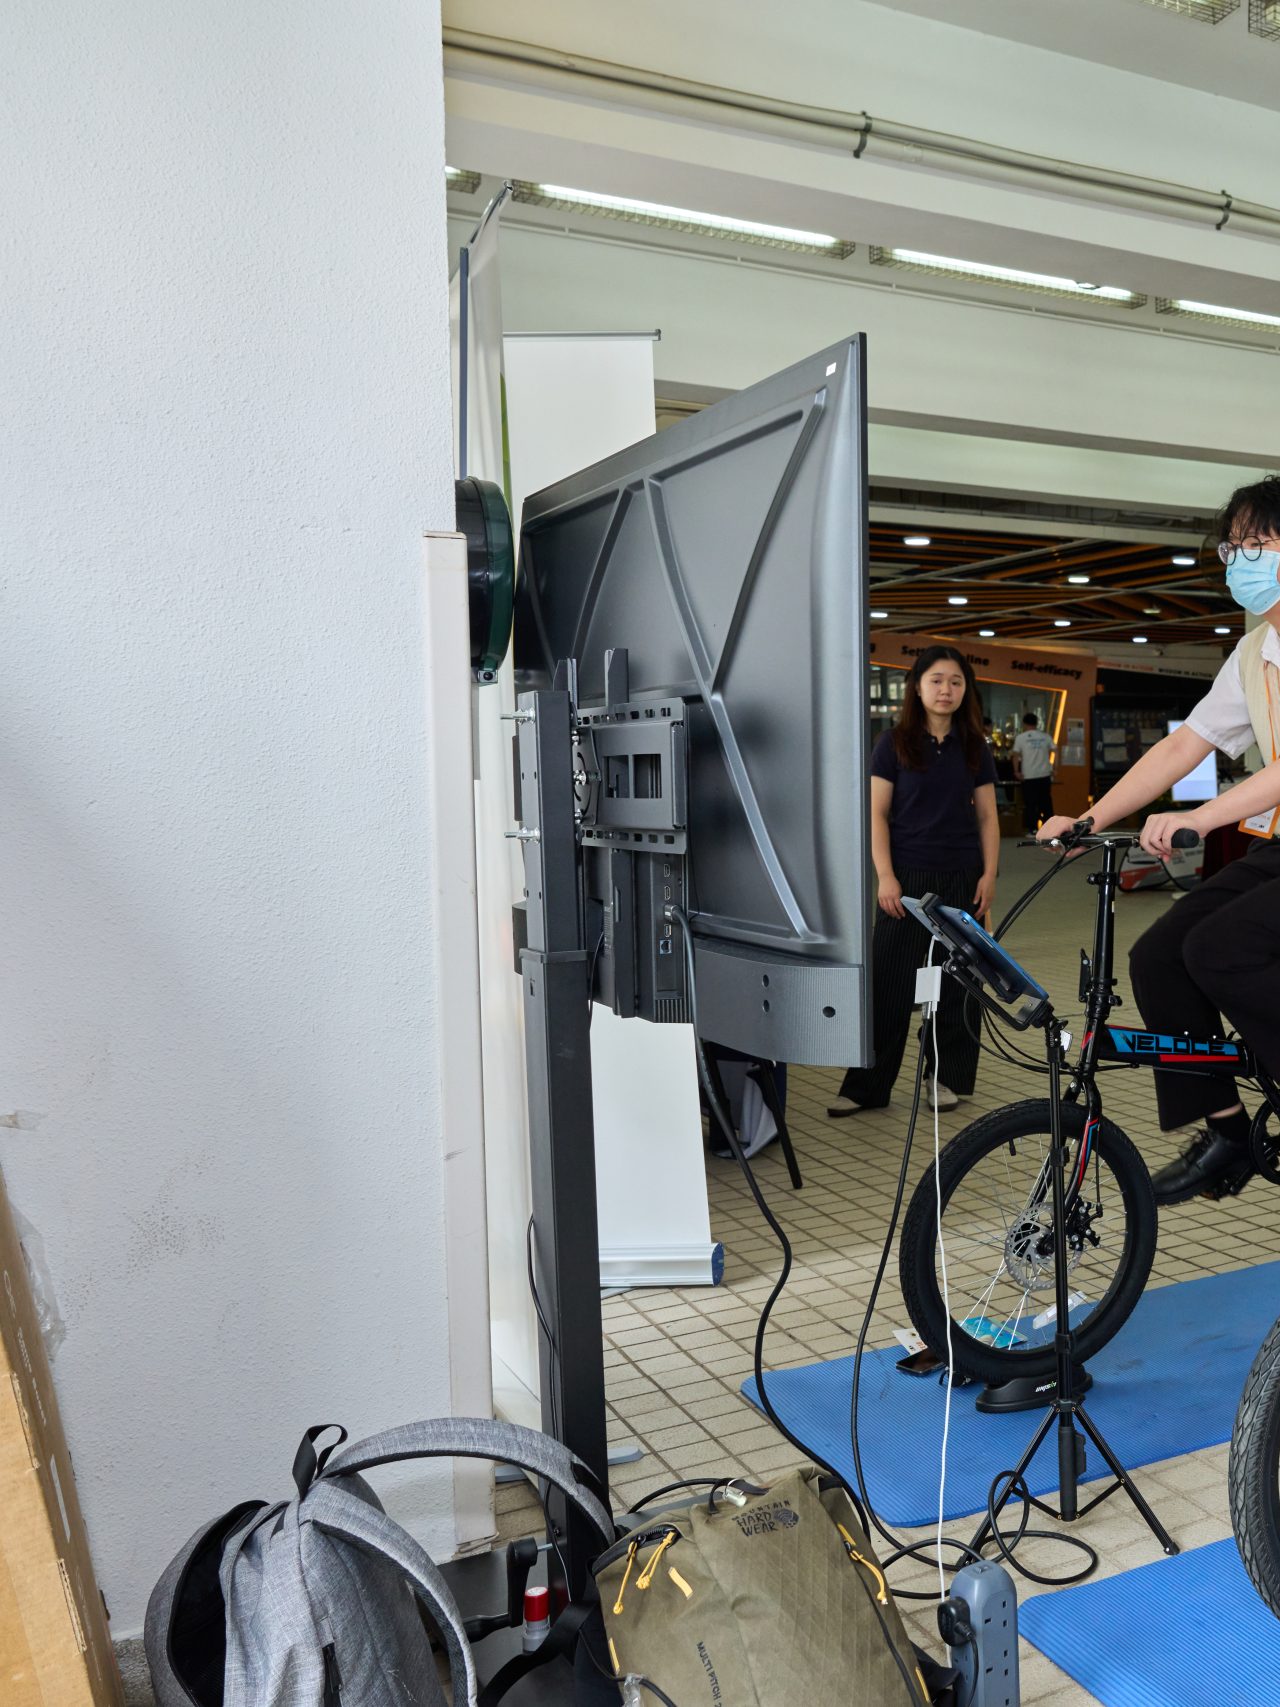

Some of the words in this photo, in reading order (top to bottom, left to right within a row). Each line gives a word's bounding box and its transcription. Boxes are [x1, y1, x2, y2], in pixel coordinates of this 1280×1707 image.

[1011, 660, 1082, 680] Self-efficacy
[1121, 1032, 1225, 1056] VELOCE
[732, 1500, 791, 1521] MOUNTAIN
[737, 1512, 772, 1527] HARD
[741, 1521, 779, 1537] WEAR
[696, 1641, 713, 1672] MULTI
[708, 1670, 722, 1701] PITCH
